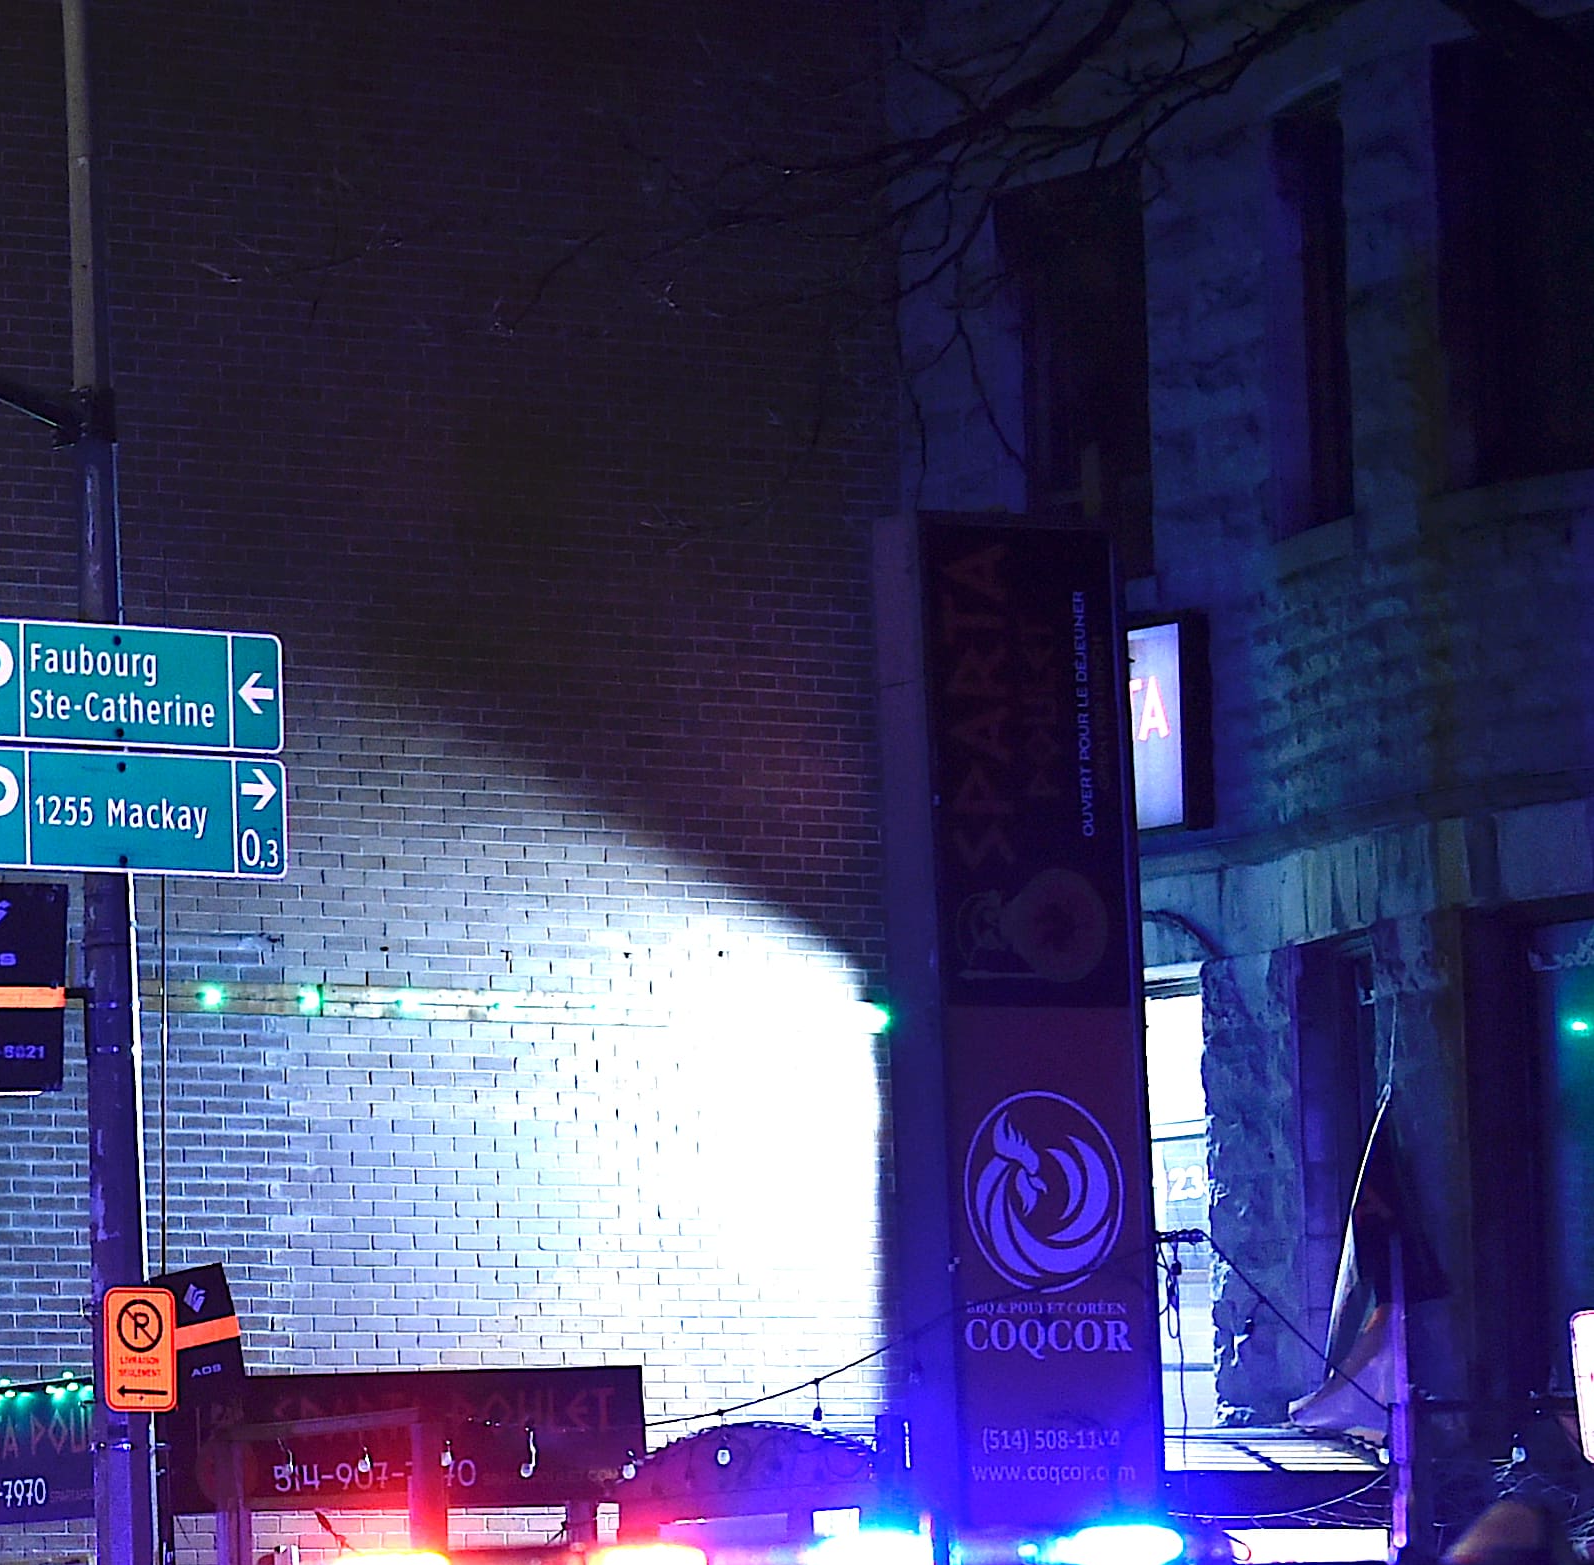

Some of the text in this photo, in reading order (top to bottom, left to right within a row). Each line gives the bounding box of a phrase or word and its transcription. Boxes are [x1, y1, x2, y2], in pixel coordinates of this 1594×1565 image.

[30, 643, 158, 687] Faubourg
[29, 689, 216, 728] Ste-Catherine
[1072, 591, 1095, 837] OUVERT POUR LE DÉJEUNER
[34, 795, 208, 839] 1255 Mackay
[240, 828, 280, 869] 0,3
[1067, 1299, 1127, 1315] CORÉEN
[964, 1318, 1134, 1361] COQCOR
[191, 1363, 222, 1377] ADS
[982, 1427, 1030, 1455] (514)
[971, 1464, 1137, 1486] www.coqcor.cm
